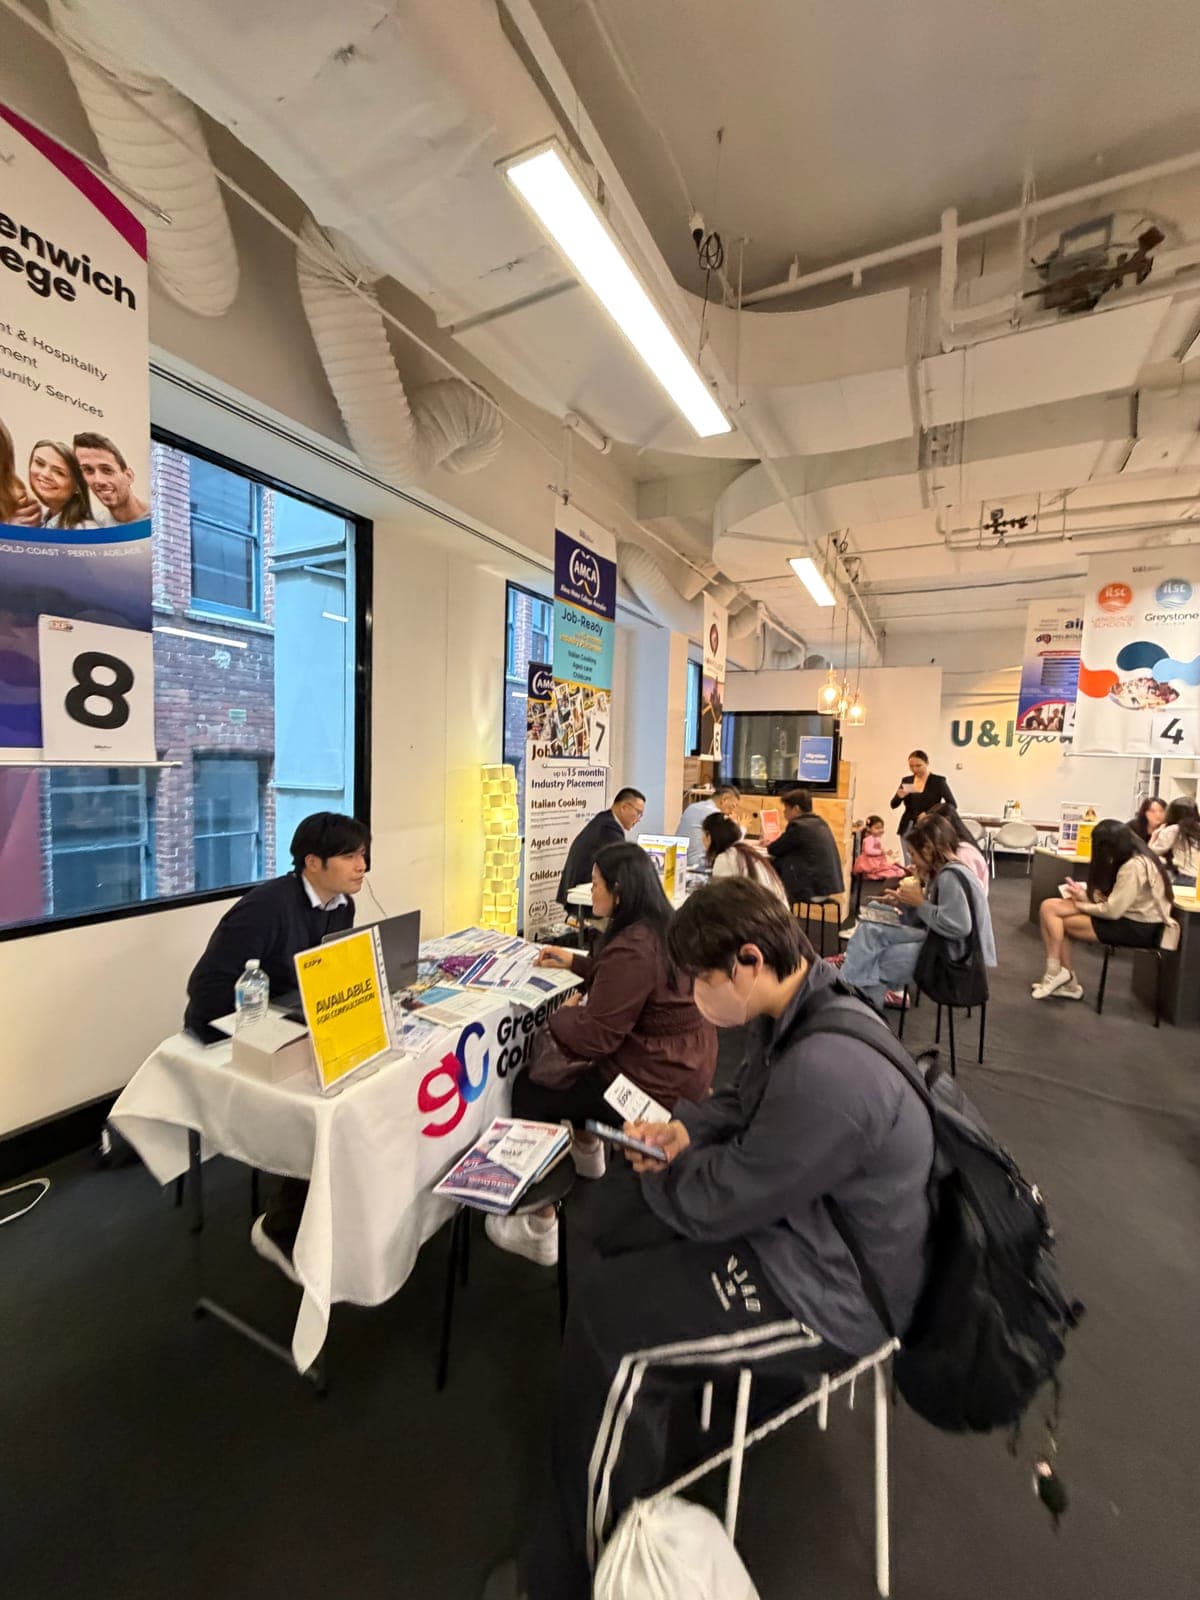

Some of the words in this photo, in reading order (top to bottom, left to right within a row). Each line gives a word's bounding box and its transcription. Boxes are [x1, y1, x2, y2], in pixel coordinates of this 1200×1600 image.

[17, 329, 29, 342] &
[32, 336, 108, 382] Hospitality
[45, 384, 104, 418] Services
[26, 545, 60, 557] COAST
[574, 560, 597, 583] AMCA
[561, 607, 604, 637] Job-Ready
[1144, 611, 1200, 624] Greystone
[64, 651, 135, 730] 8
[595, 721, 606, 753] 7
[1159, 718, 1185, 746] 4
[531, 779, 566, 791] Industry
[566, 778, 604, 789] Placement
[531, 798, 557, 809] Italian
[557, 797, 587, 809] Cooking
[531, 835, 551, 850] Aged
[552, 836, 568, 845] care
[529, 869, 562, 881] Childcar
[315, 977, 373, 1015] AVAILABLE
[316, 1011, 332, 1026] FOR
[330, 991, 376, 1020] CONSULTATION
[496, 1030, 536, 1078] Coll
